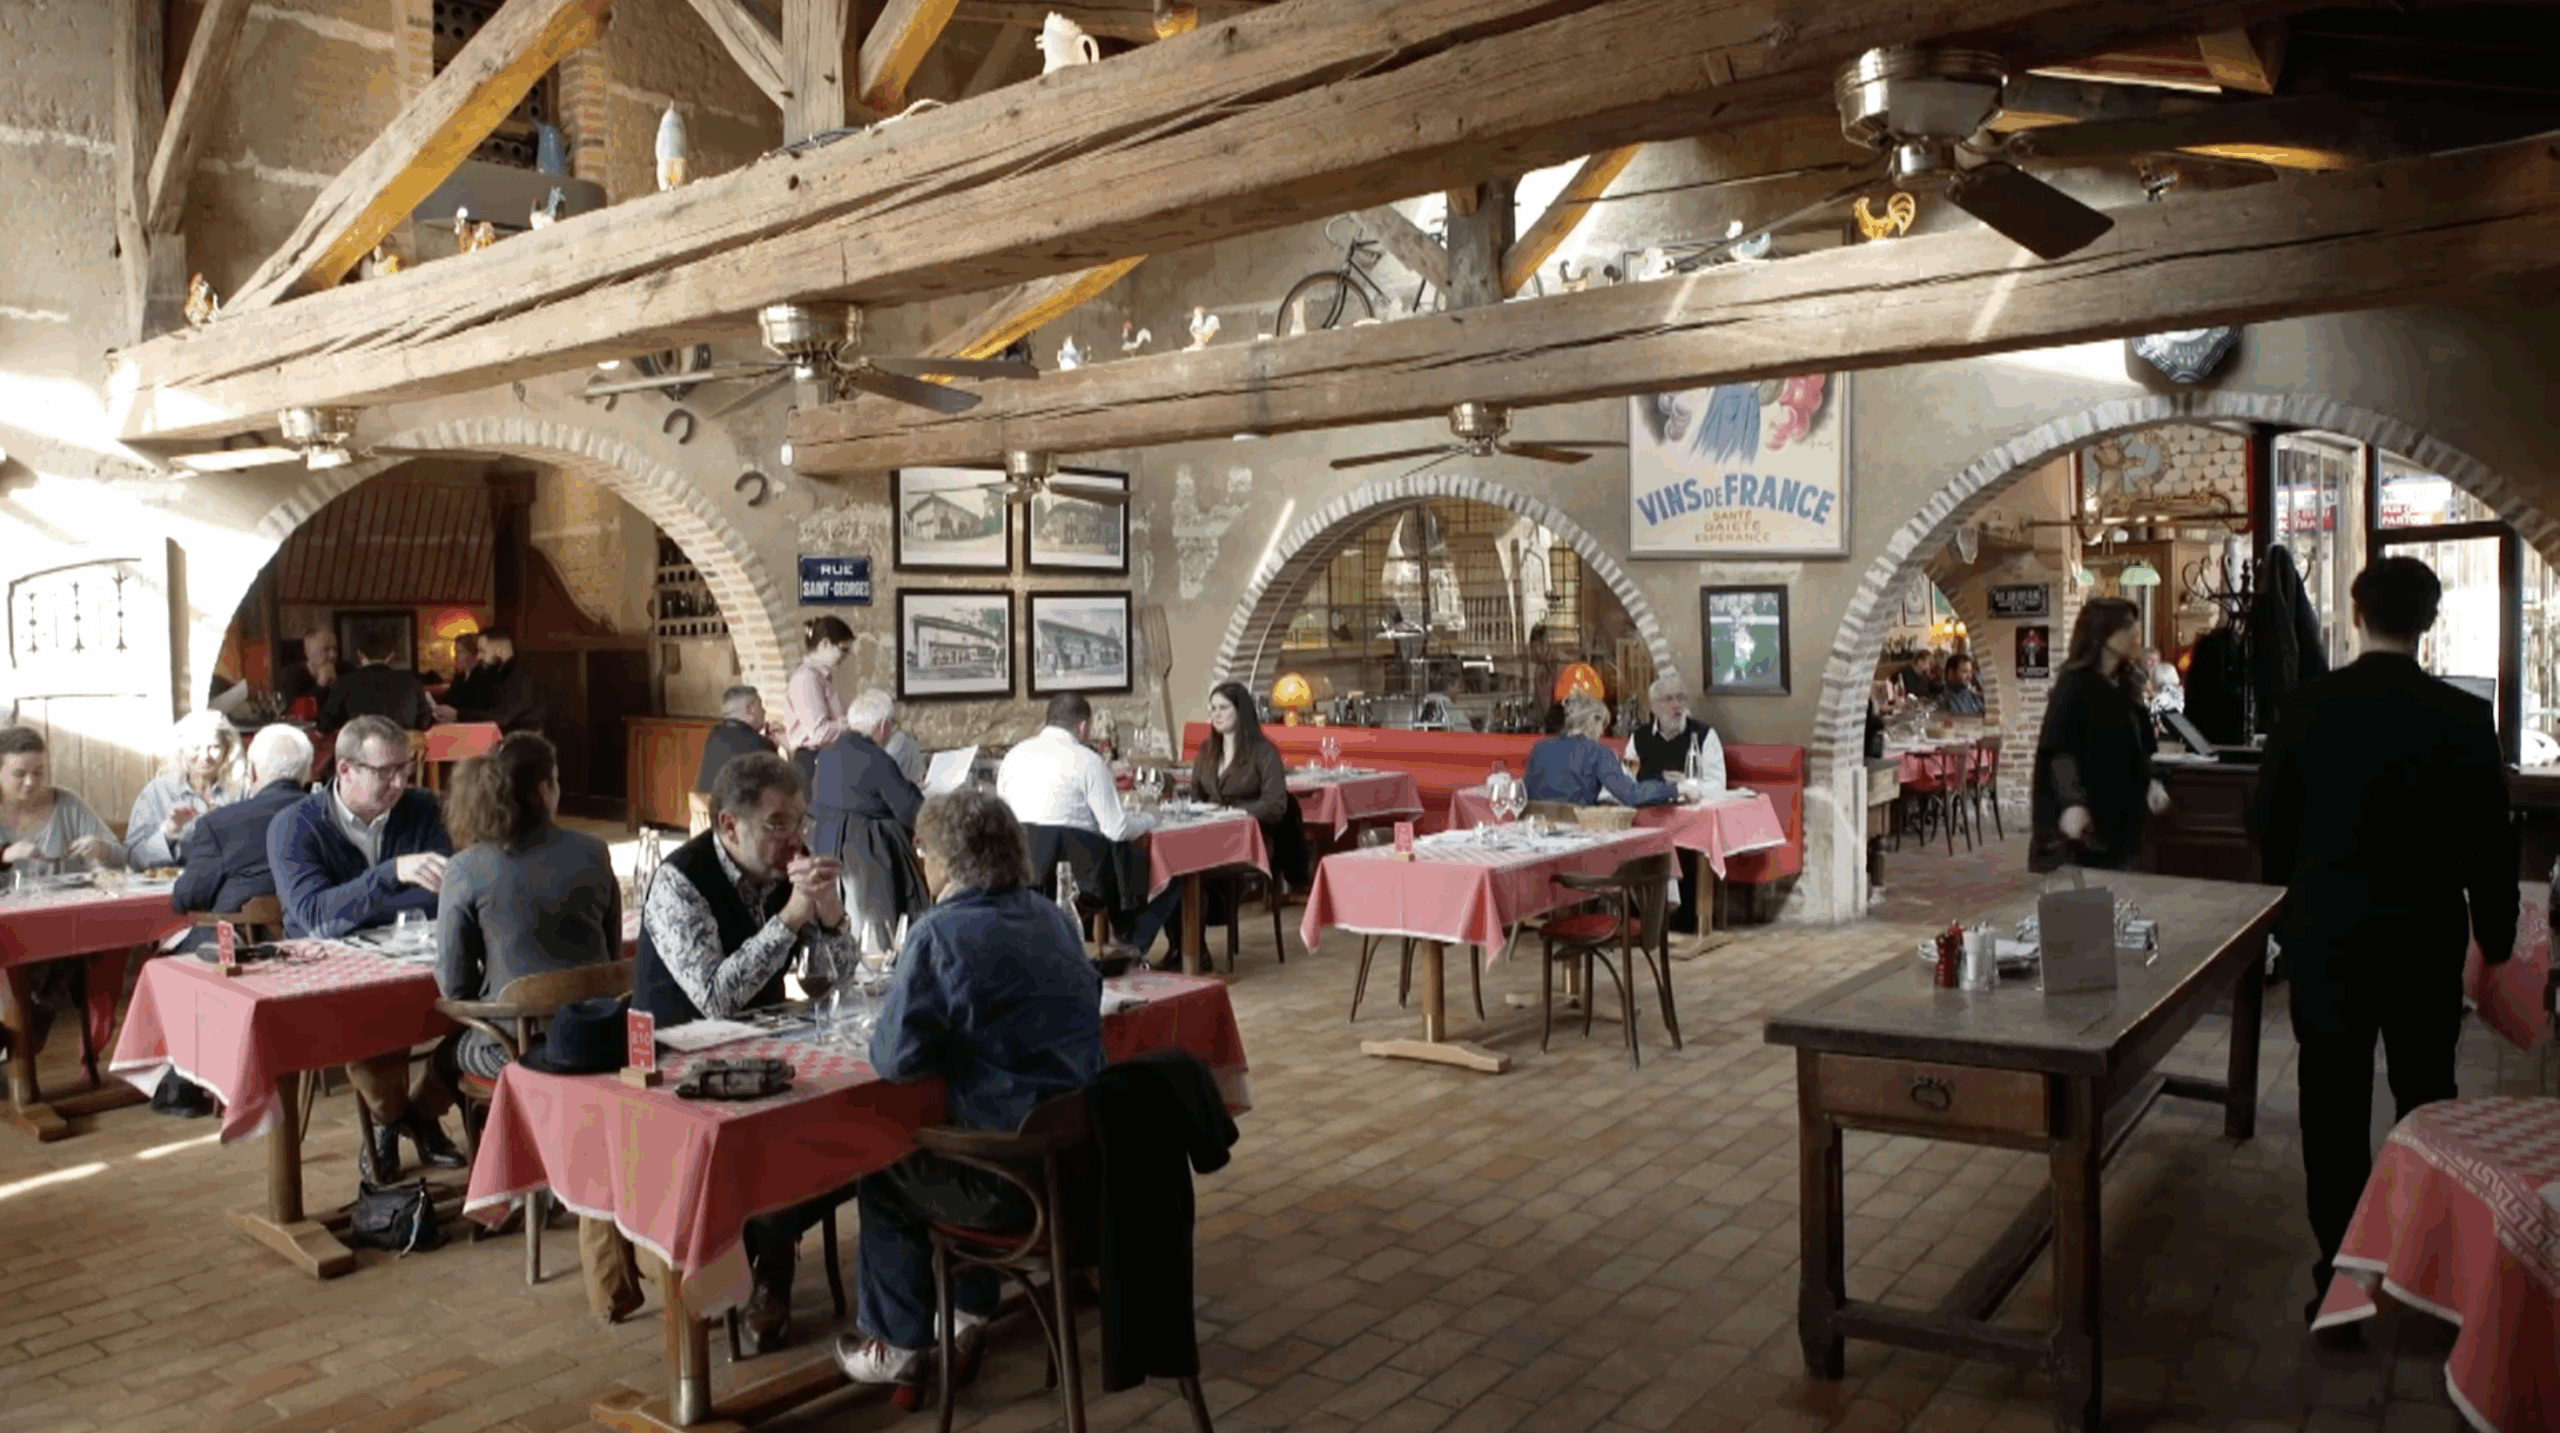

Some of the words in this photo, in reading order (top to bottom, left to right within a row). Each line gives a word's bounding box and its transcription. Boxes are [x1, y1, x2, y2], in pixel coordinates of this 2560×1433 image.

[1636, 478, 1702, 526] VINS
[1703, 486, 1723, 509] DE
[1724, 473, 1836, 525] FRANCE
[820, 563, 854, 576] RUE
[803, 581, 870, 597] SAINT-GEORGES
